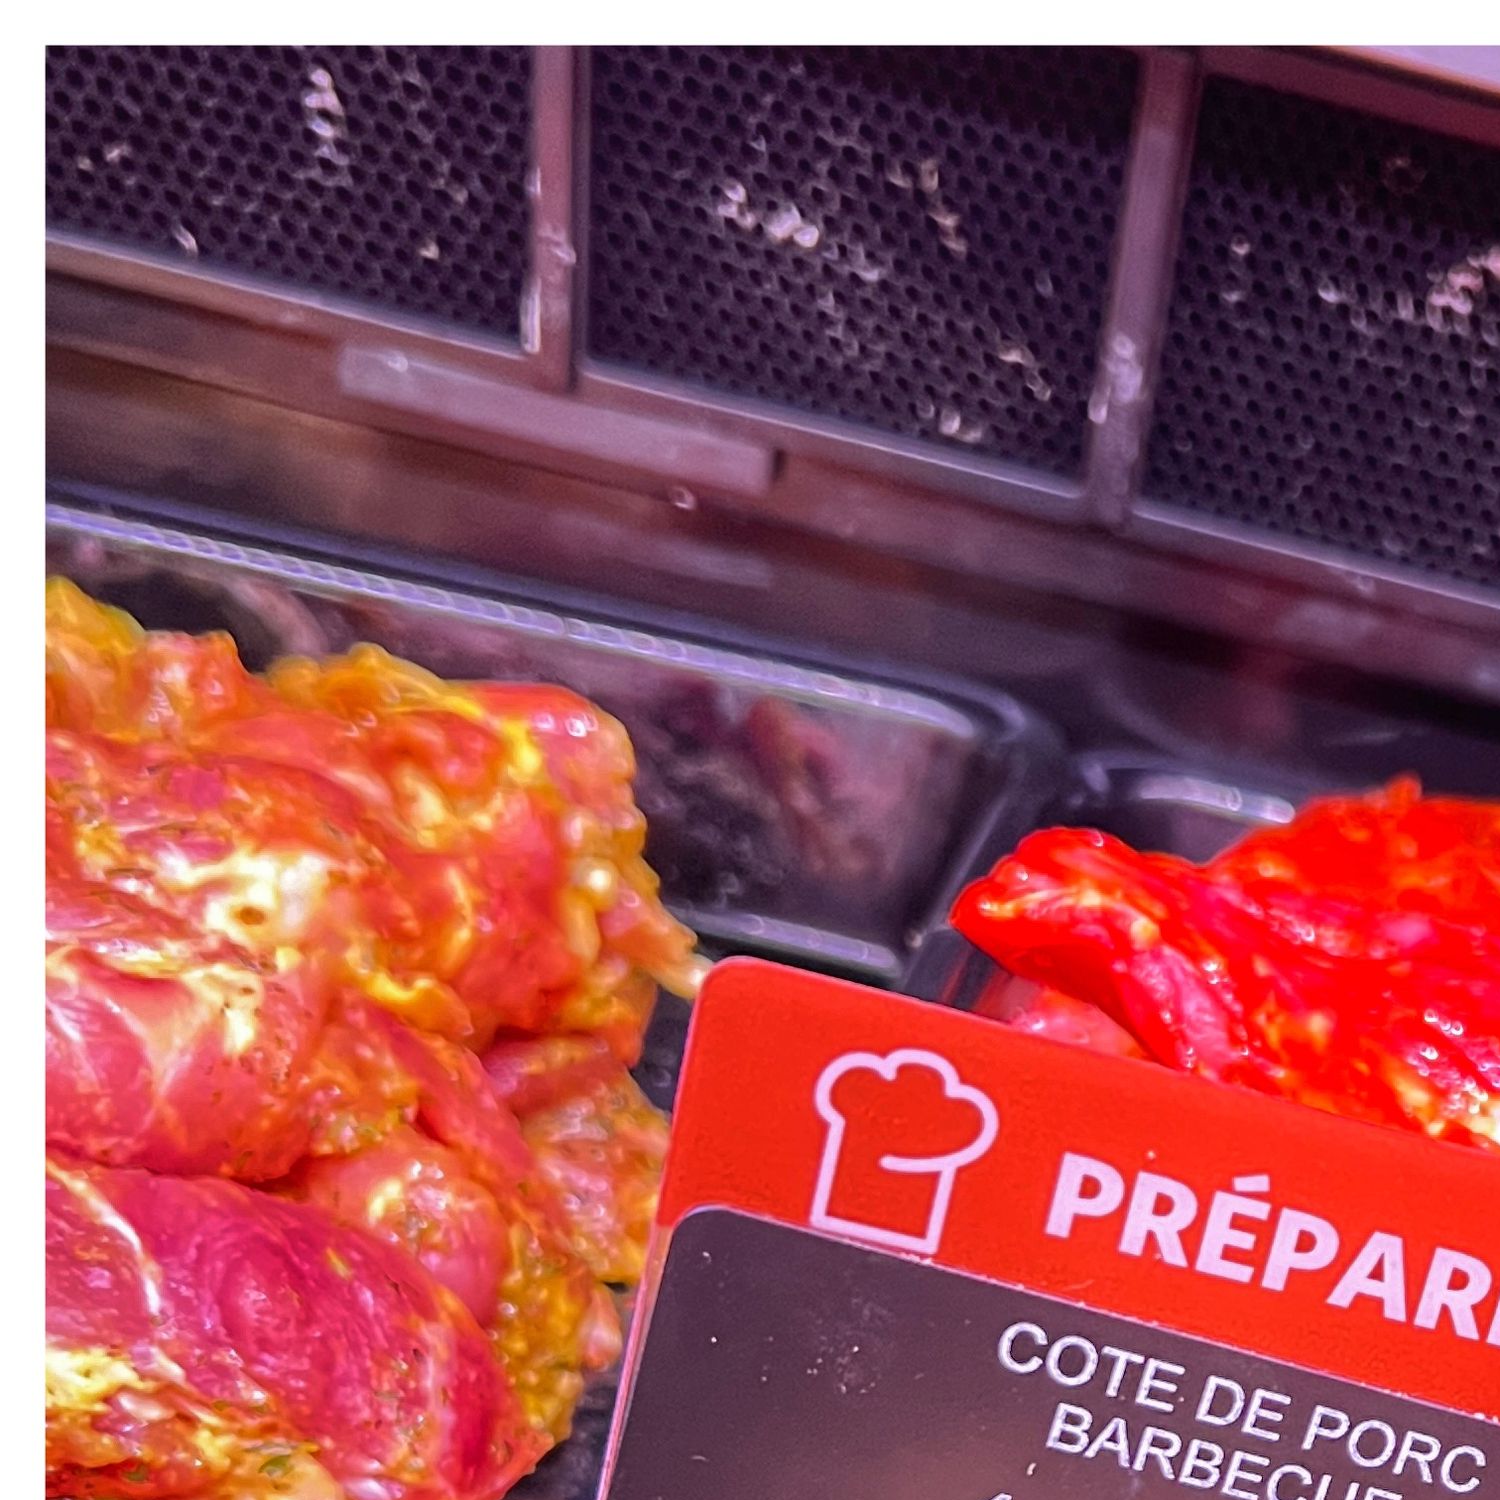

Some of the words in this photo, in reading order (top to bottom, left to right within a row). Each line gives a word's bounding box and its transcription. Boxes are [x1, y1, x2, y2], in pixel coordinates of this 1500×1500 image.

[996, 1321, 1189, 1414] COTE
[1197, 1375, 1293, 1442] DE
[1301, 1405, 1488, 1495] PORC
